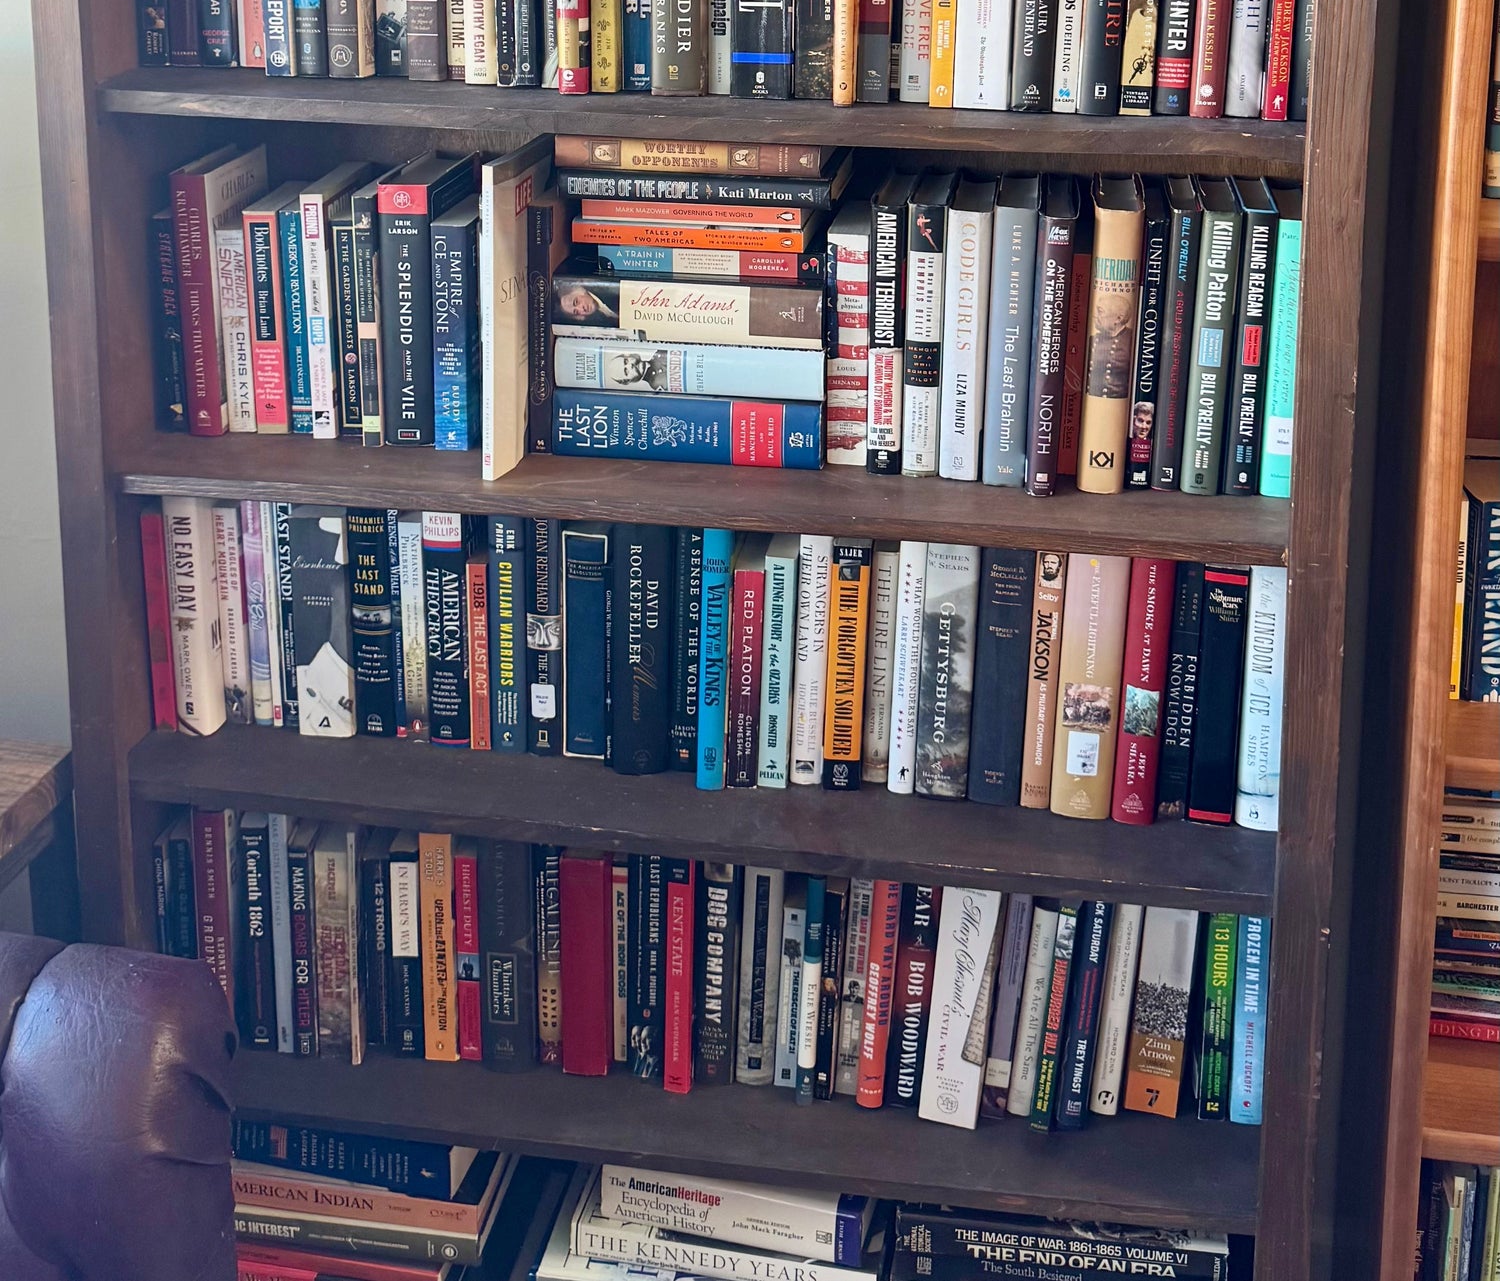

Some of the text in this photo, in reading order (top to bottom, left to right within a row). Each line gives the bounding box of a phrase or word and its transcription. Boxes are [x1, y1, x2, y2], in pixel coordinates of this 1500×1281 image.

[568, 177, 699, 199] ENEMIES OF THE PEOPLE
[719, 186, 792, 201] Kati Marton
[1207, 221, 1233, 268] Killing
[631, 286, 670, 307] John
[874, 212, 896, 346] AMERICAN TERRORIST
[1205, 274, 1228, 321] Patton
[397, 262, 412, 344] SPLENDID
[402, 385, 415, 420] VILE
[1000, 326, 1019, 451] The Last Brahmin
[558, 407, 573, 442] THE
[576, 404, 591, 448] LAST
[593, 406, 608, 448] LION
[173, 516, 197, 612] NO EASY DAY
[499, 562, 513, 686] CIVILIAN WARRIORS
[629, 544, 642, 664] ROCKEFELLER
[647, 580, 658, 629] DAVID
[1033, 610, 1052, 680] JACKSON
[833, 585, 859, 756] THE FORGOTTEN SOLDIER
[933, 602, 955, 744] GETTYSBURG
[705, 886, 728, 1023] DOG COMPANY
[1213, 928, 1230, 988] 13 HOURS
[1244, 918, 1261, 1013] FROZEN IN TIME
[898, 961, 925, 1097] BOB WOODWARD
[1146, 1038, 1171, 1051] Zinn
[1139, 1049, 1176, 1062] Arnove
[313, 1188, 374, 1211] INDIAN
[610, 1176, 625, 1188] The
[614, 1205, 715, 1235] American History
[622, 1192, 711, 1221] Encyclopedia of
[585, 1233, 817, 1281] THE KENNEDY YEARS
[955, 1228, 1188, 1264] THE IMAGE OF WAR: 1861-1865 VOLUME VI
